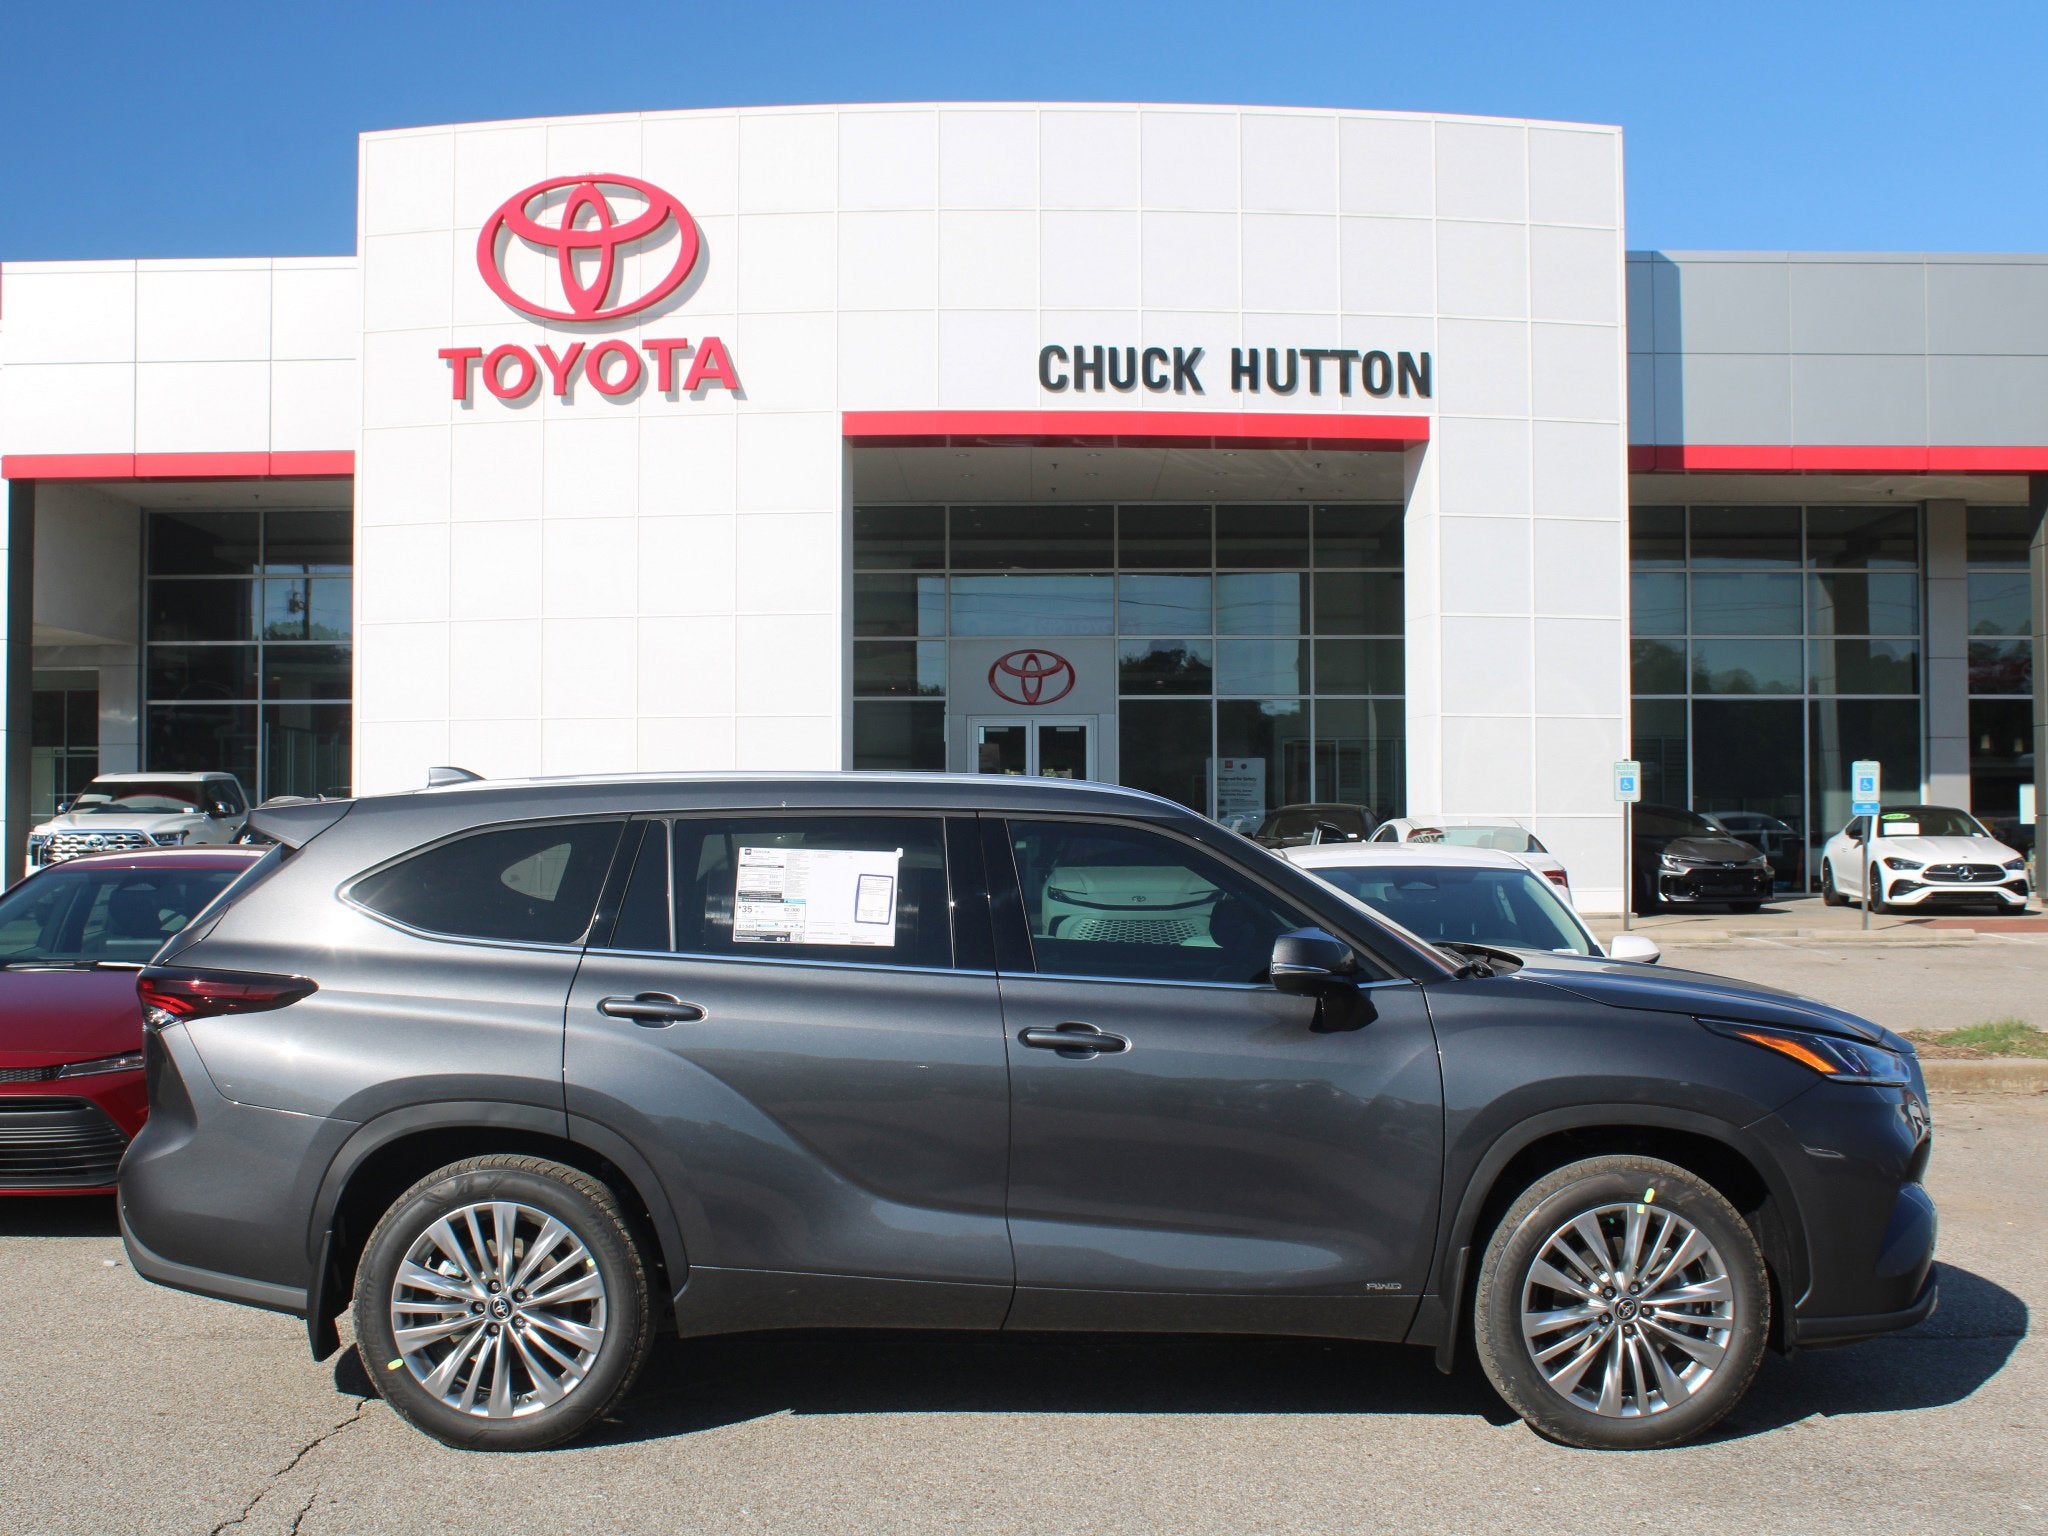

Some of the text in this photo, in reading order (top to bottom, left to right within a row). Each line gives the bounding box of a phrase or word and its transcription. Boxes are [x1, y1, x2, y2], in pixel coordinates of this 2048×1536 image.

[438, 337, 739, 400] TOYOTA
[1038, 345, 1431, 398] CHUCK HUTTON
[1366, 1282, 1402, 1290] AWD
